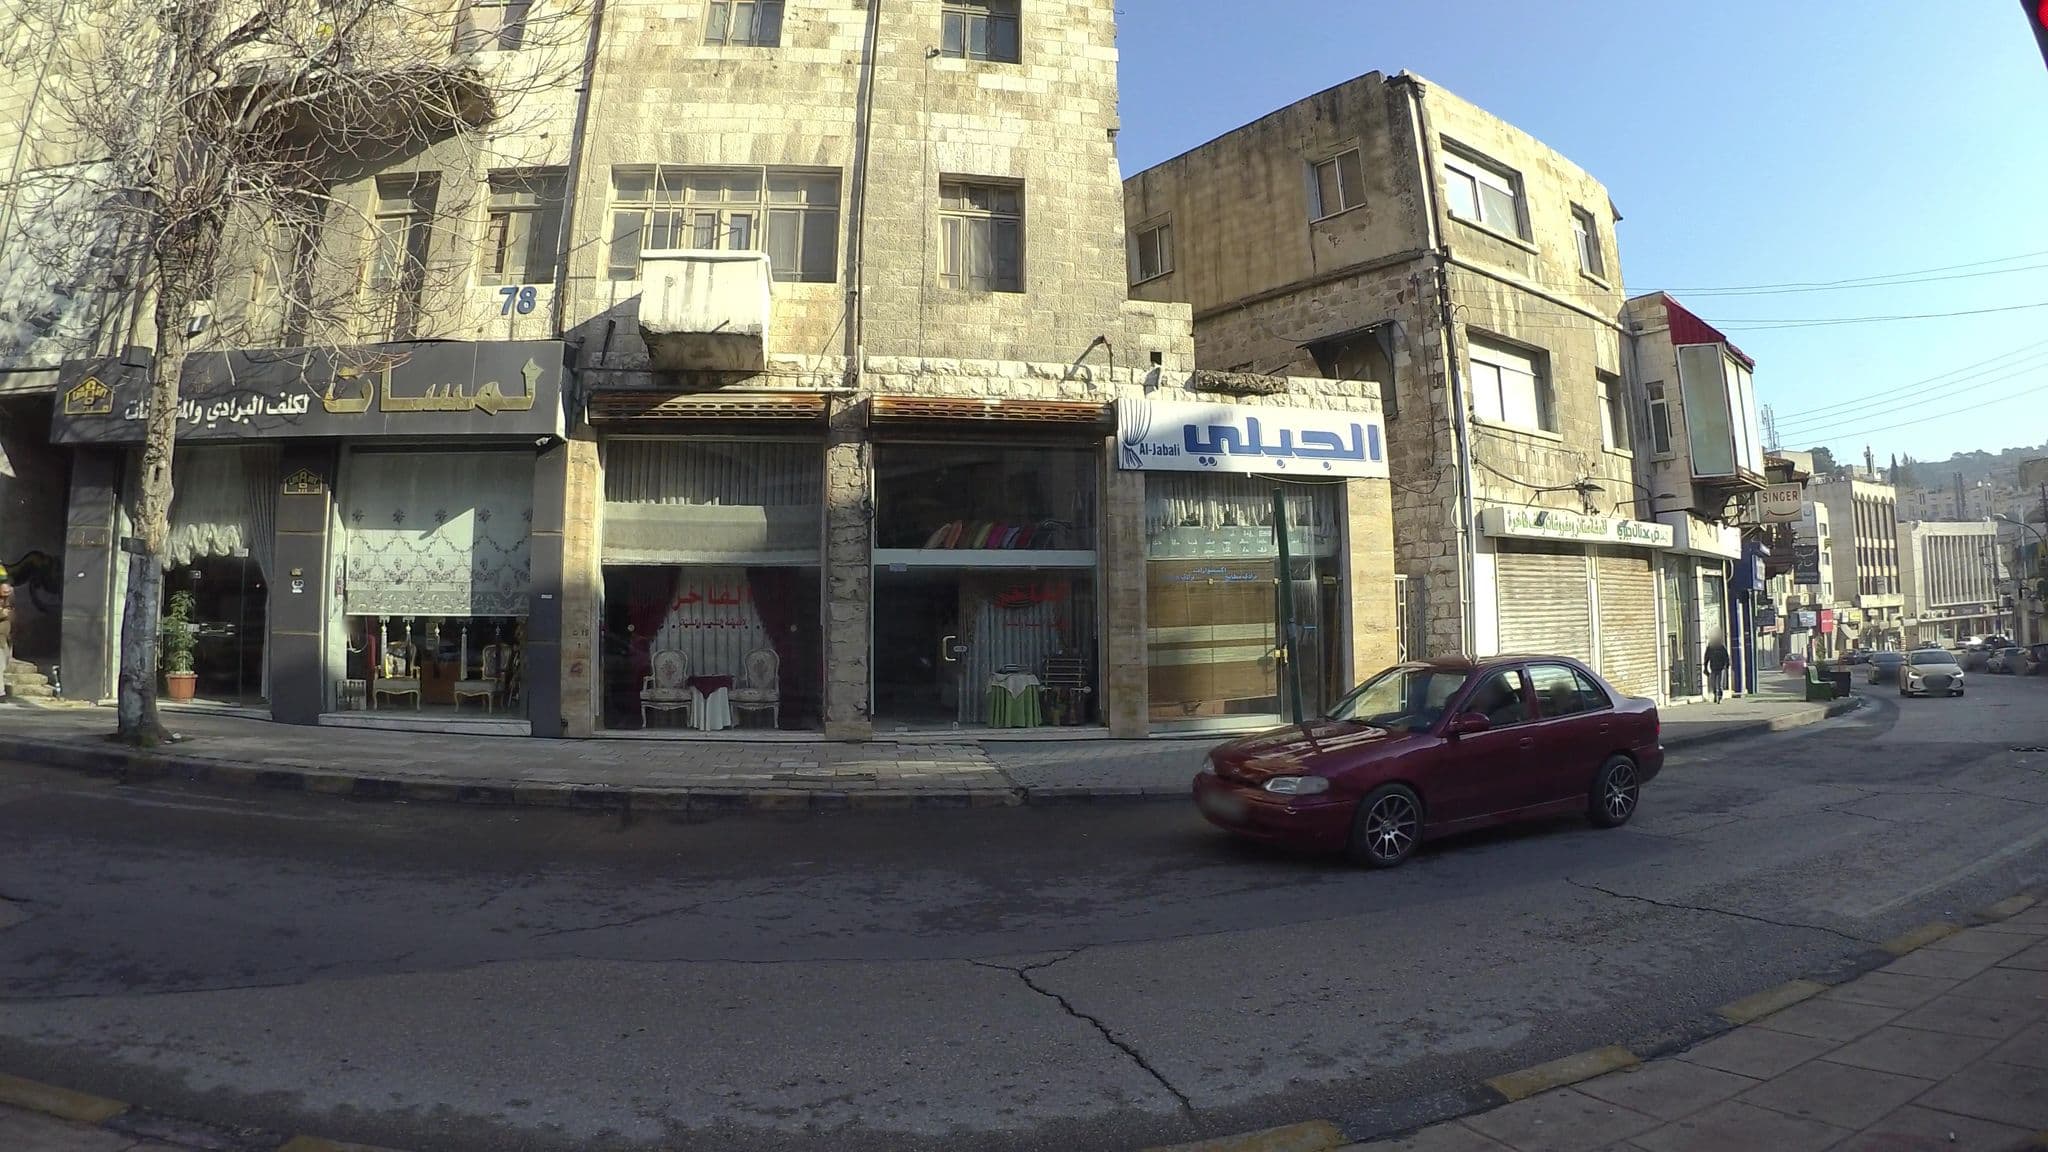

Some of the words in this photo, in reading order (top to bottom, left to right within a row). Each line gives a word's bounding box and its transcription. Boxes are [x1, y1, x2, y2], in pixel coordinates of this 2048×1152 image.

[499, 286, 537, 315] 78
[322, 358, 545, 415] لمسات
[206, 396, 264, 428] البرادي
[266, 392, 310, 415] لكلف
[1139, 441, 1181, 457] Al-Jabali
[1183, 416, 1382, 470] الجبلي
[1762, 490, 1798, 503] SINGER
[672, 583, 753, 611] الفاخر
